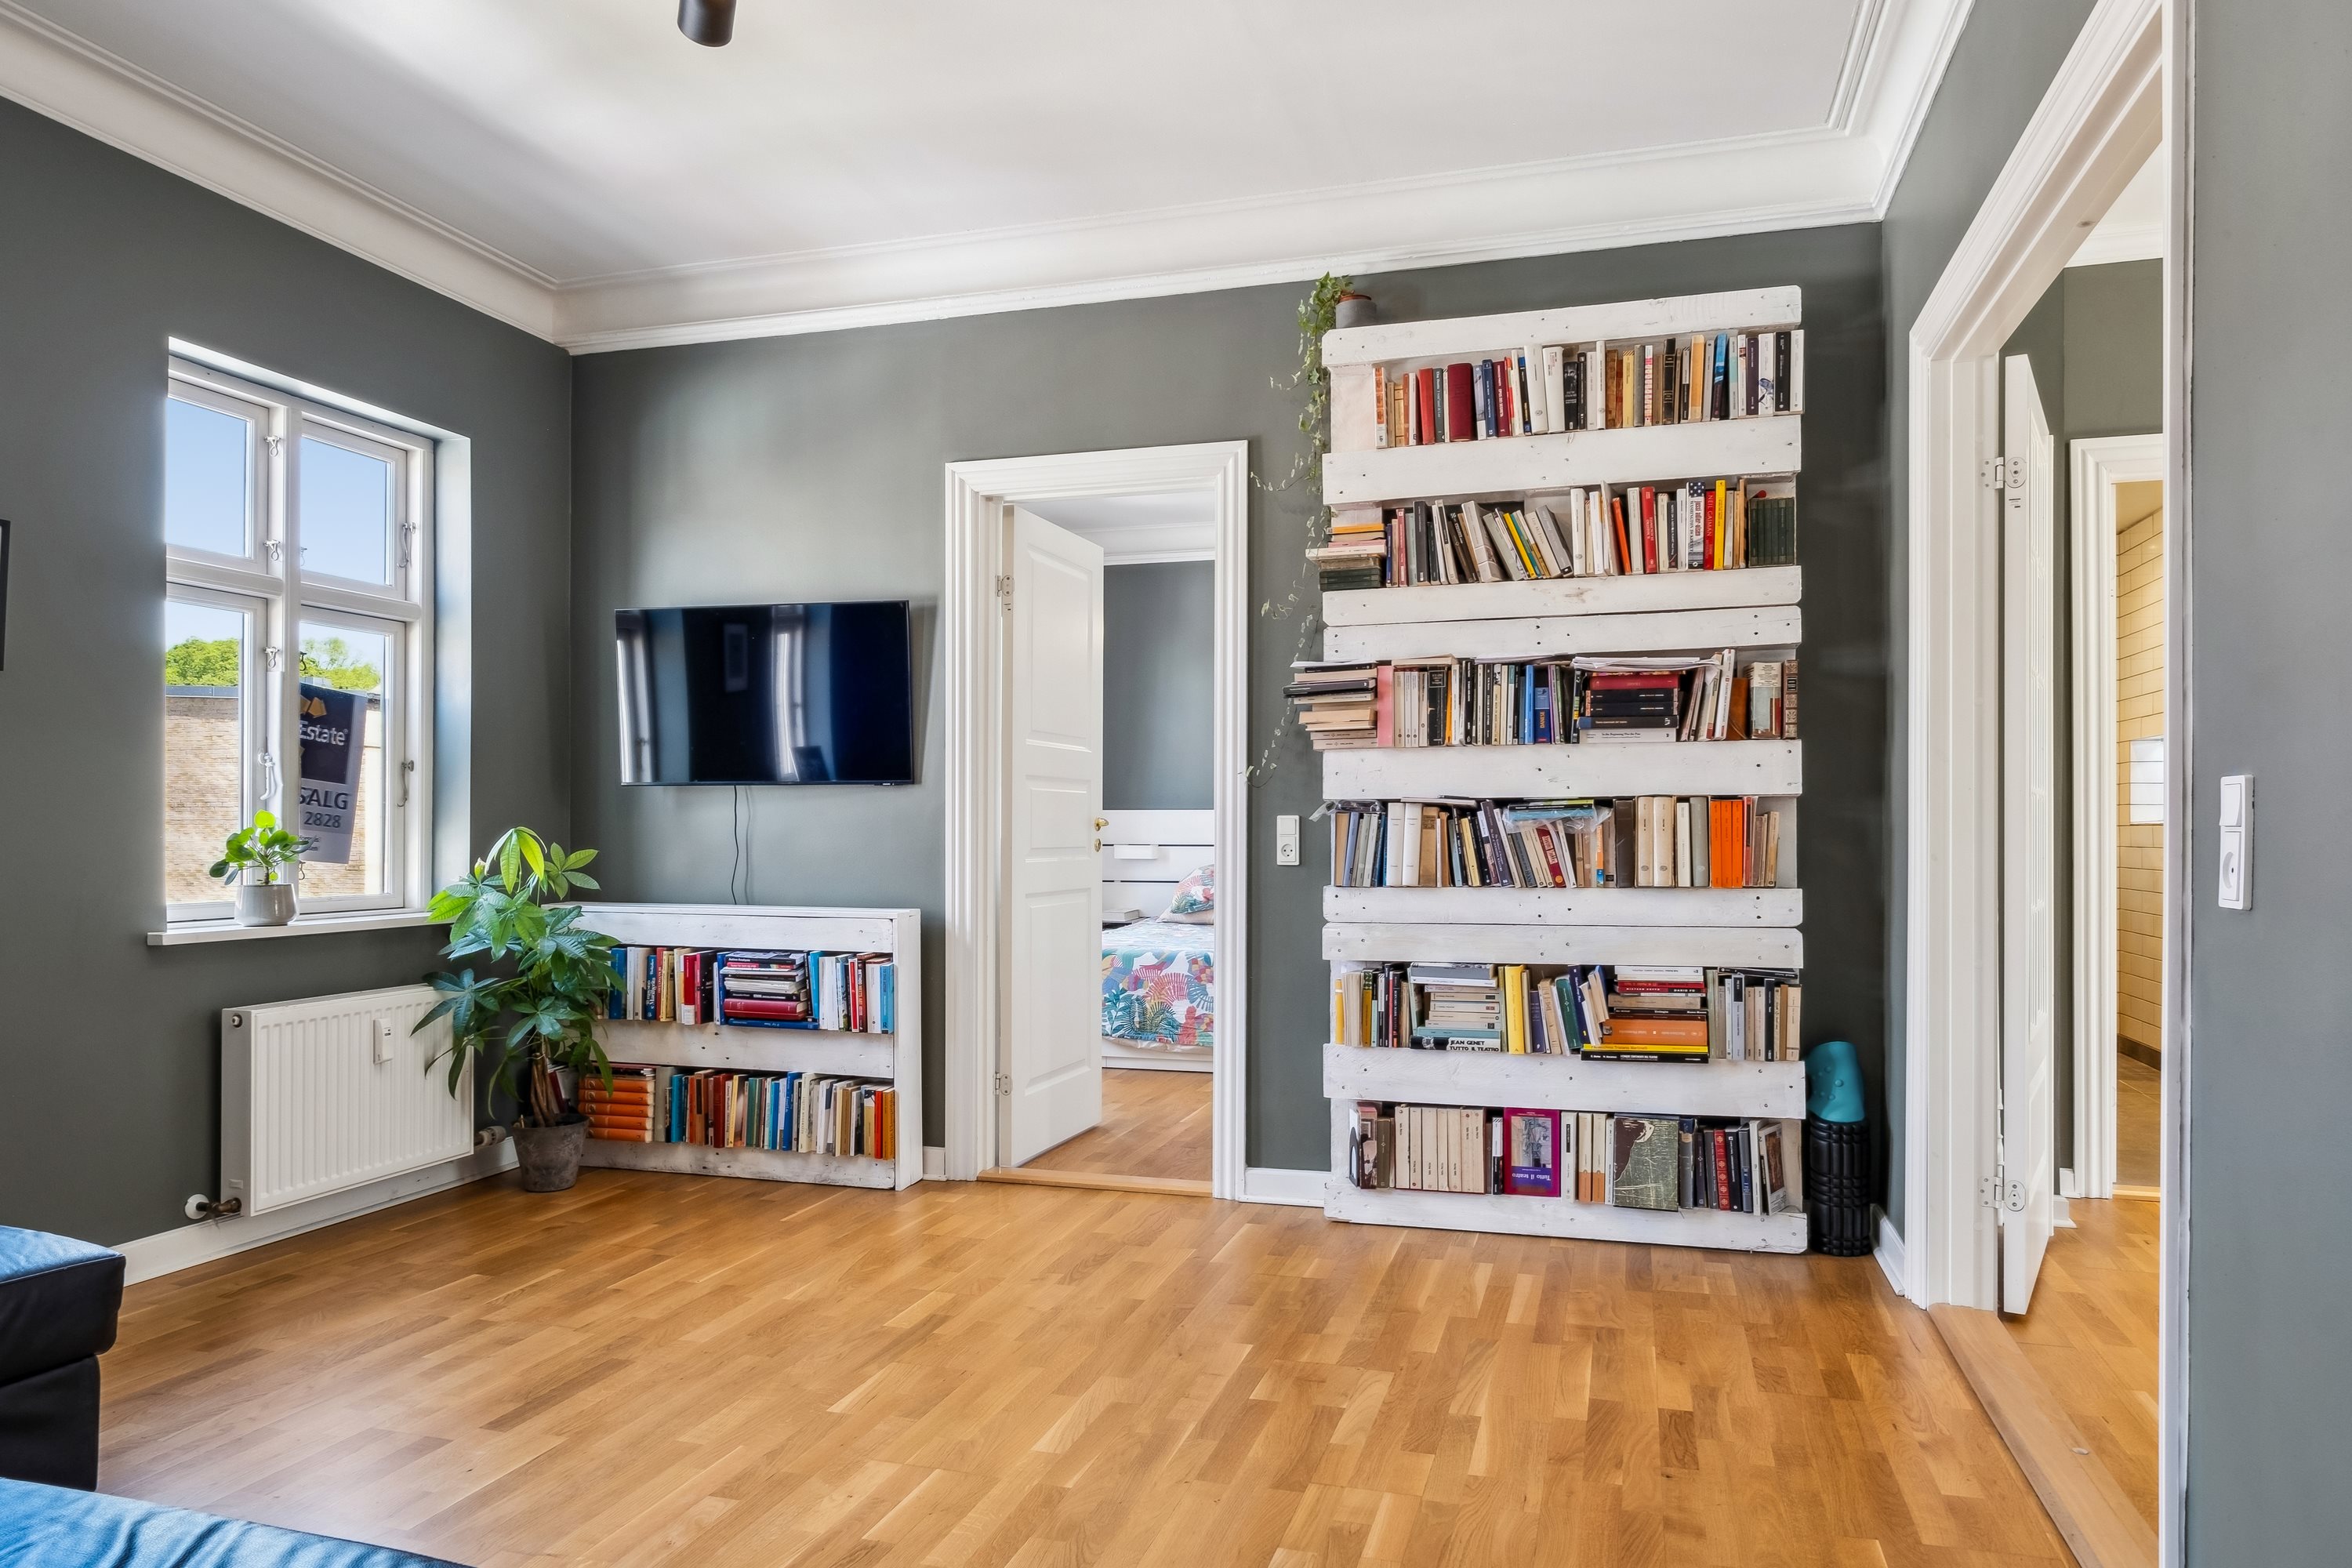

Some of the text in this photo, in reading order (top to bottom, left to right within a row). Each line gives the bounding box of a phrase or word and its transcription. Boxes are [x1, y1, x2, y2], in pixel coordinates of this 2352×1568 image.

[300, 720, 345, 746] Estate
[299, 787, 348, 810] SALG
[304, 811, 340, 829] 2828
